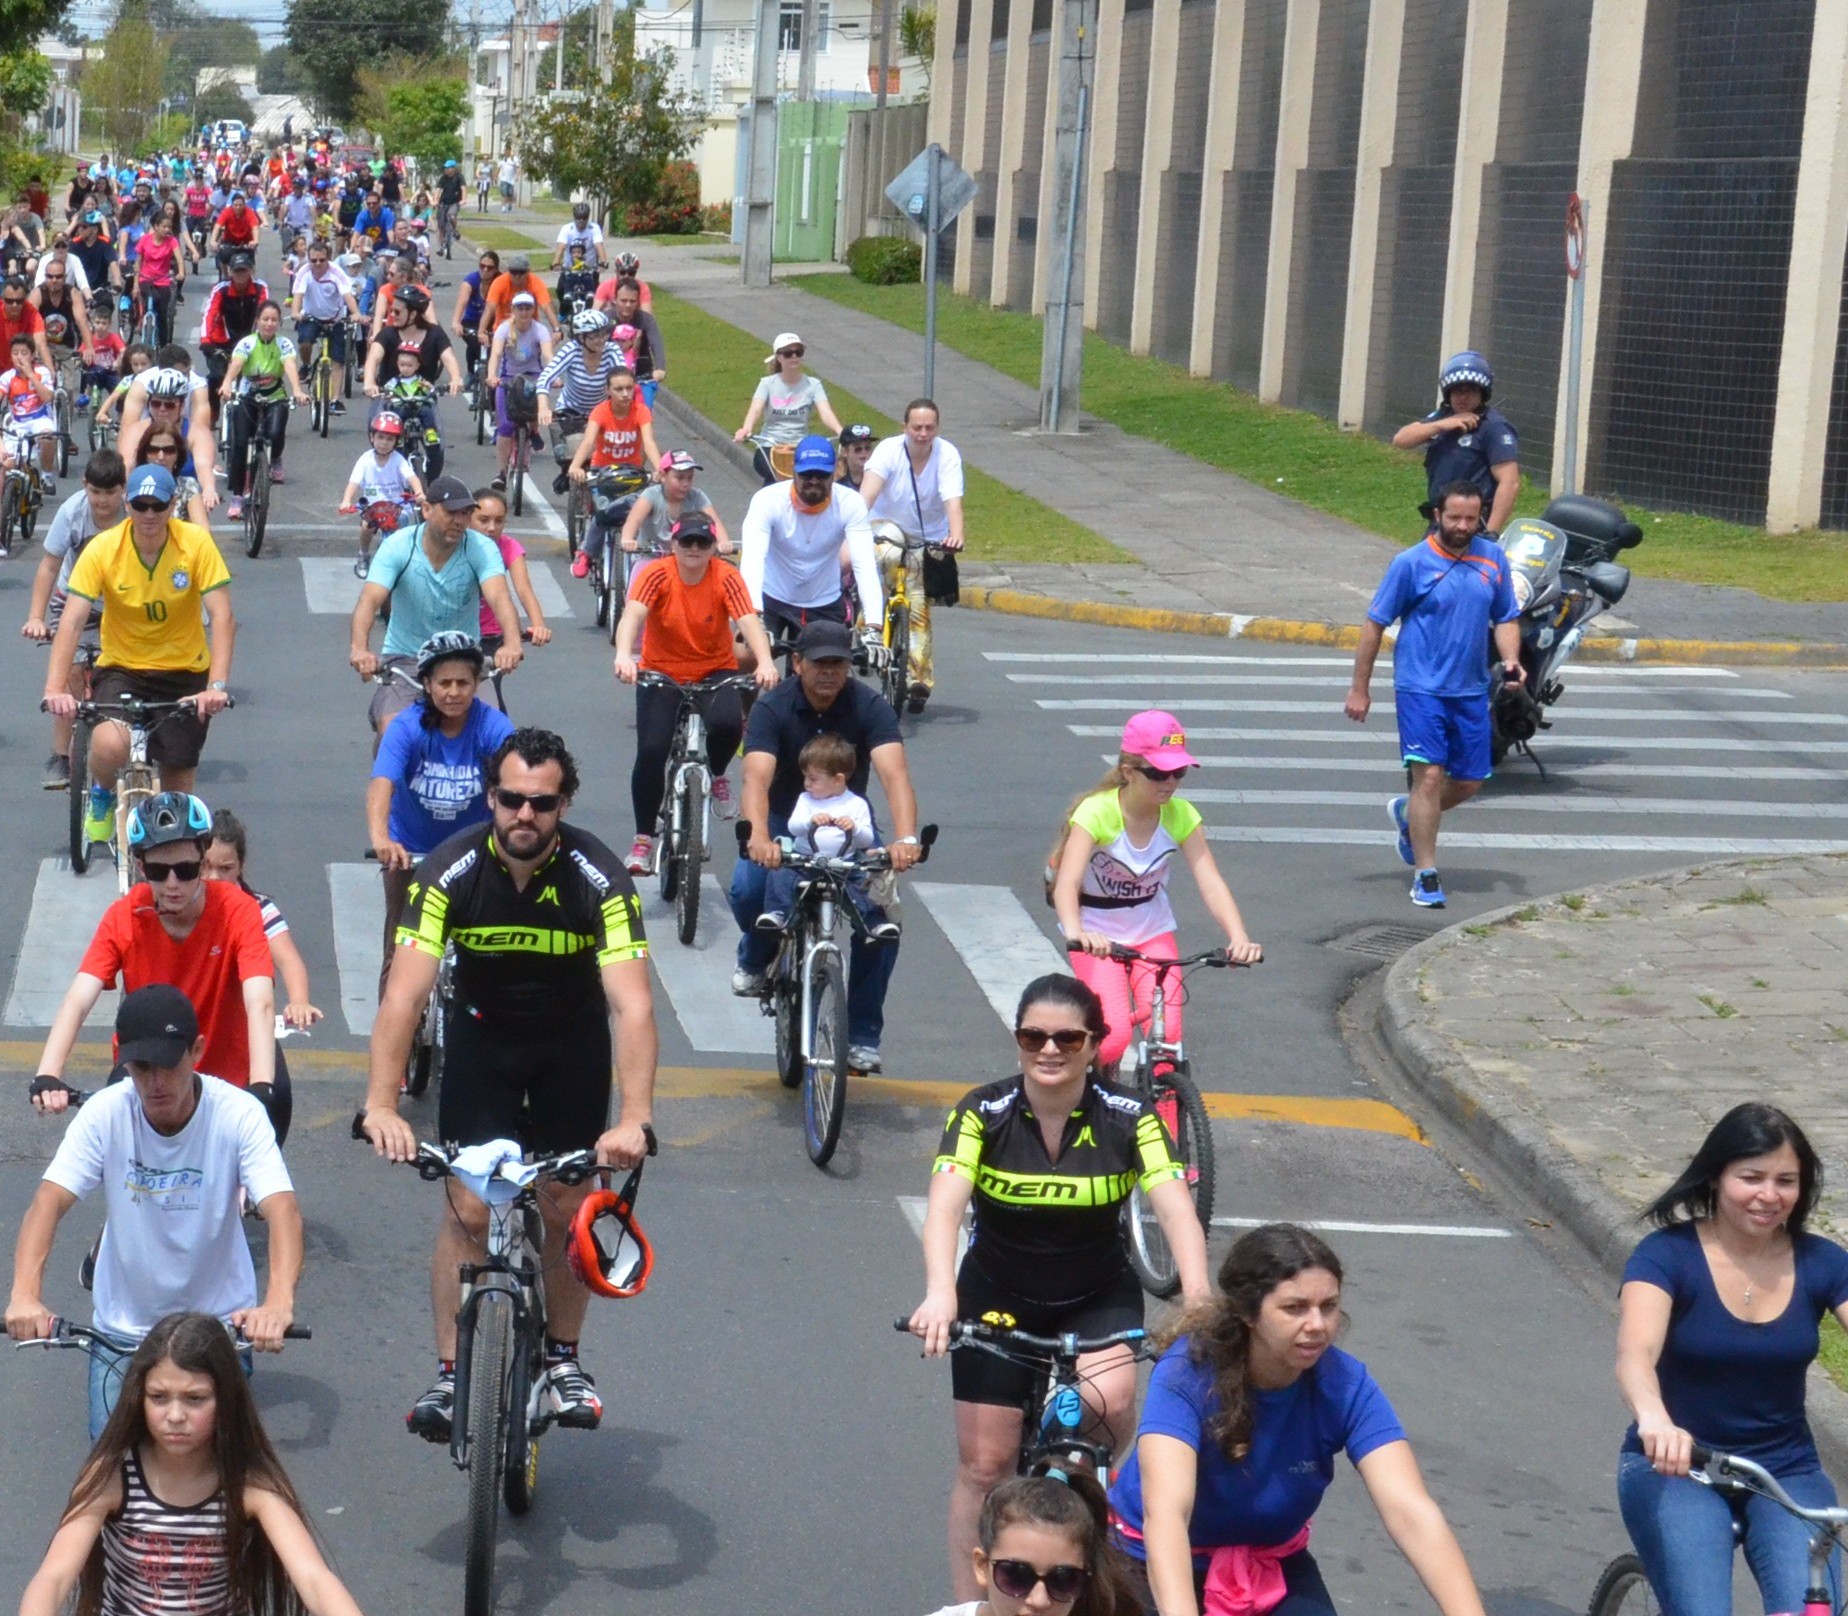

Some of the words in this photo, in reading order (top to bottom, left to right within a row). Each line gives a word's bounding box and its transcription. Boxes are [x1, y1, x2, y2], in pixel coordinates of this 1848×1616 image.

[604, 431, 637, 444] RUN
[143, 600, 167, 622] 10
[409, 774, 483, 800] NATUREZA
[1103, 876, 1142, 896] WISH
[455, 931, 539, 946] MEM
[981, 1172, 1078, 1199] MEM
